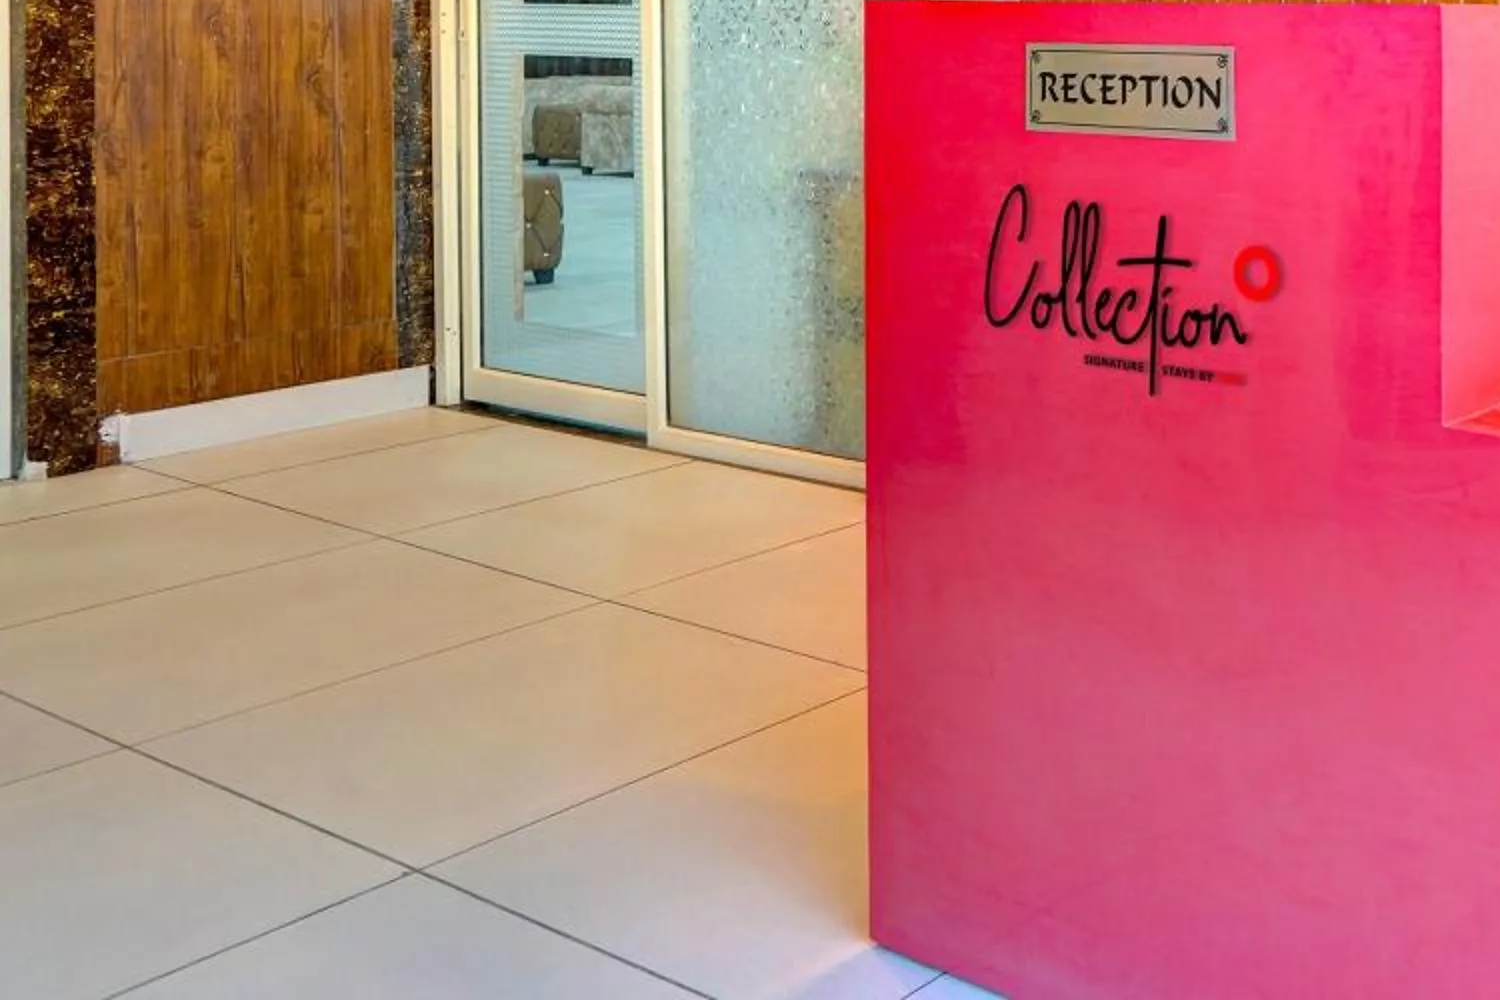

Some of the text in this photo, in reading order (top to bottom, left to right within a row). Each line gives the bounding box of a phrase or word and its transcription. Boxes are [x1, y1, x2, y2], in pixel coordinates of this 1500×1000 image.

[1039, 71, 1223, 108] RECEPTION
[983, 184, 1248, 396] Collection
[1083, 354, 1145, 373] SIGNATURE
